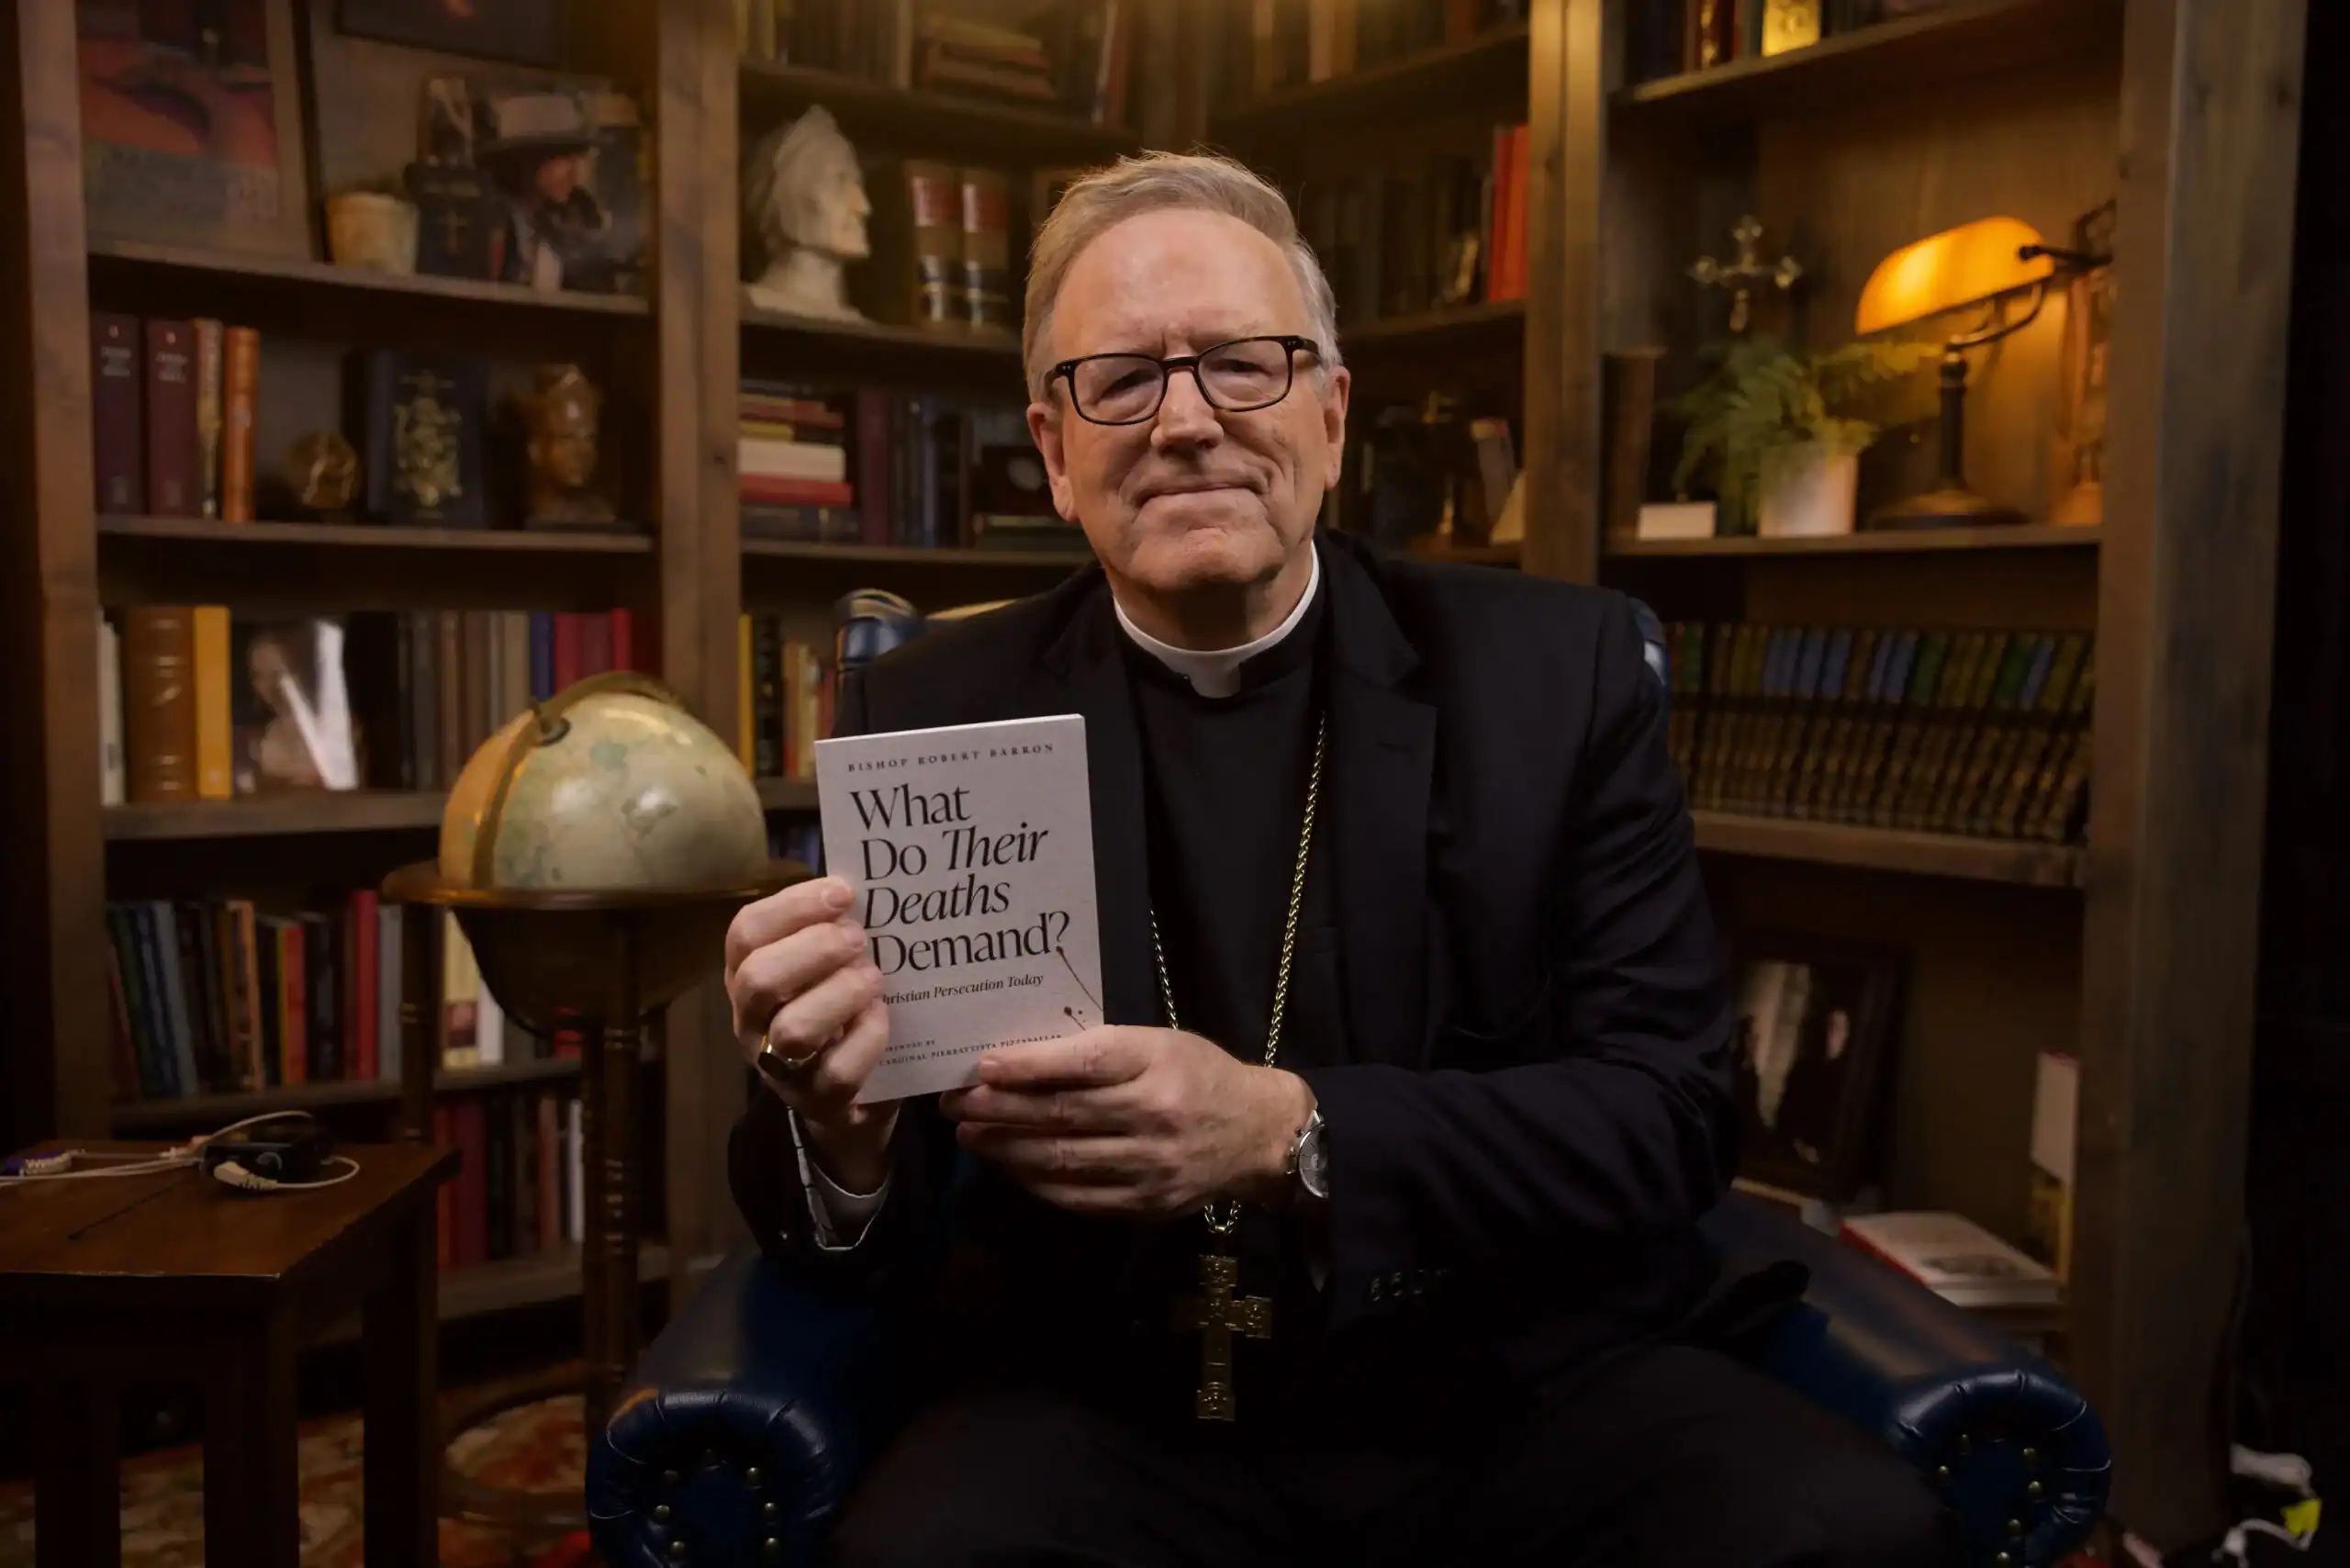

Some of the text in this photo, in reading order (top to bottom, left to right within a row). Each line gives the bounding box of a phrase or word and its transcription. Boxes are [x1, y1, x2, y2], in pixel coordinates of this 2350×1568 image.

[848, 744, 1054, 772] BISHOP ROBERT BARRON
[848, 783, 973, 831] What
[861, 822, 1049, 880] Do Their
[864, 873, 1011, 929] Deaths
[870, 911, 1070, 975] Demand?
[882, 974, 1044, 1005] hristian Persecution Today
